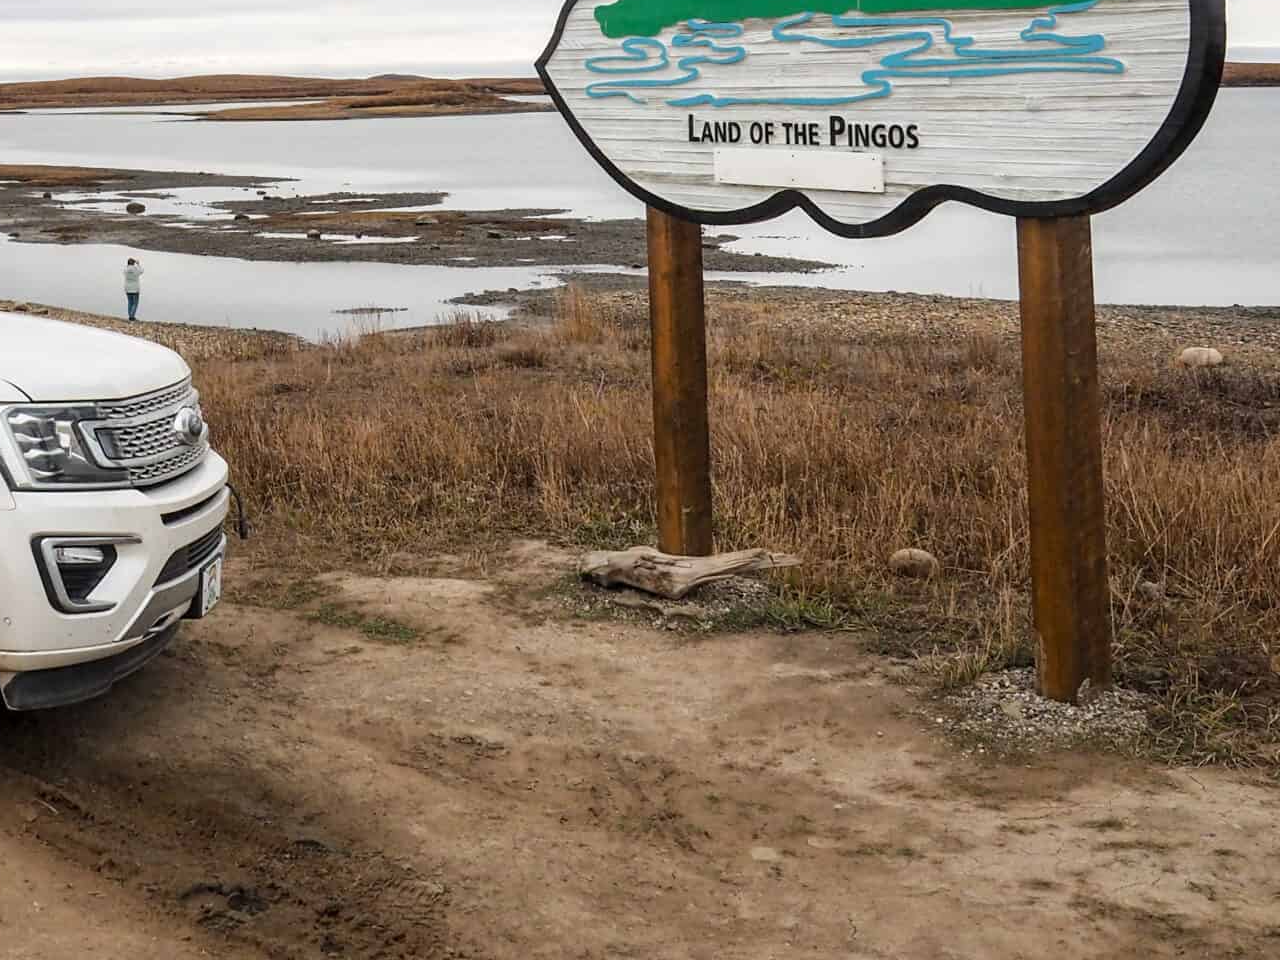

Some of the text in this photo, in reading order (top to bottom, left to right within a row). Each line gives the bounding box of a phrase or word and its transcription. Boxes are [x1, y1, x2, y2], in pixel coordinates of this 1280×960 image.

[688, 114, 919, 149] LAND OF THE PINGOS
